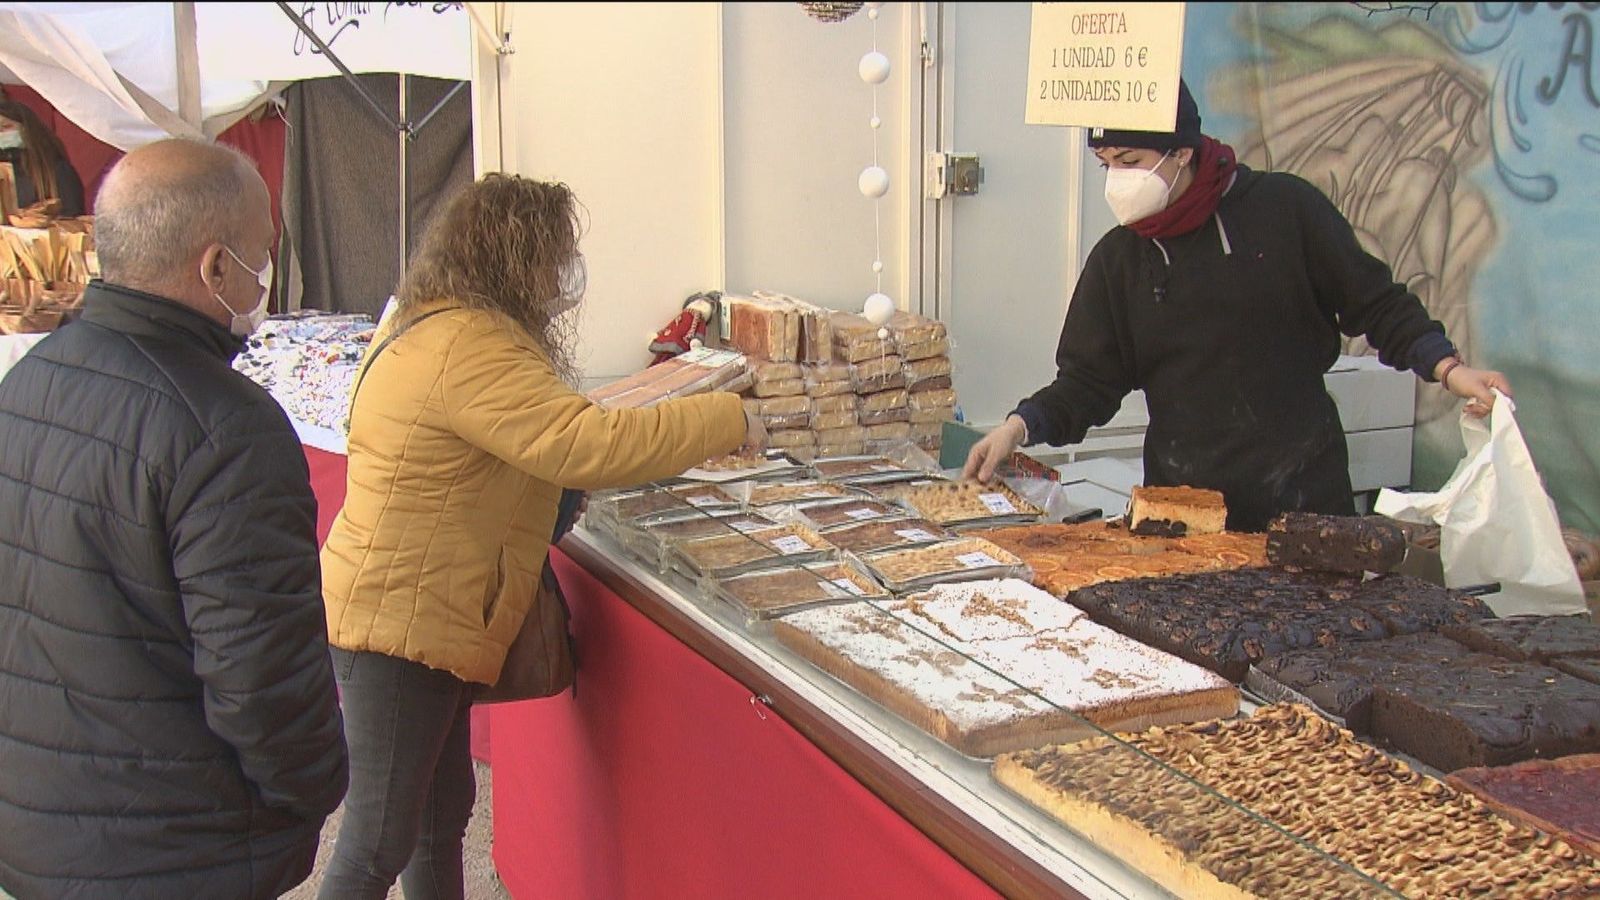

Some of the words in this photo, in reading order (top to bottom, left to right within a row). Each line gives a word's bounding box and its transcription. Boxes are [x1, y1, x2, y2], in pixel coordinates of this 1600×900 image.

[1071, 12, 1127, 35] OFERTA
[1051, 47, 1057, 68] 1
[1062, 46, 1116, 68] UNIDAD
[1124, 46, 1133, 68] 6
[1137, 46, 1148, 68] €
[1039, 80, 1048, 100] 2
[1051, 80, 1121, 102] UNIDADES
[1126, 80, 1143, 103] 10
[1146, 81, 1158, 103] €
